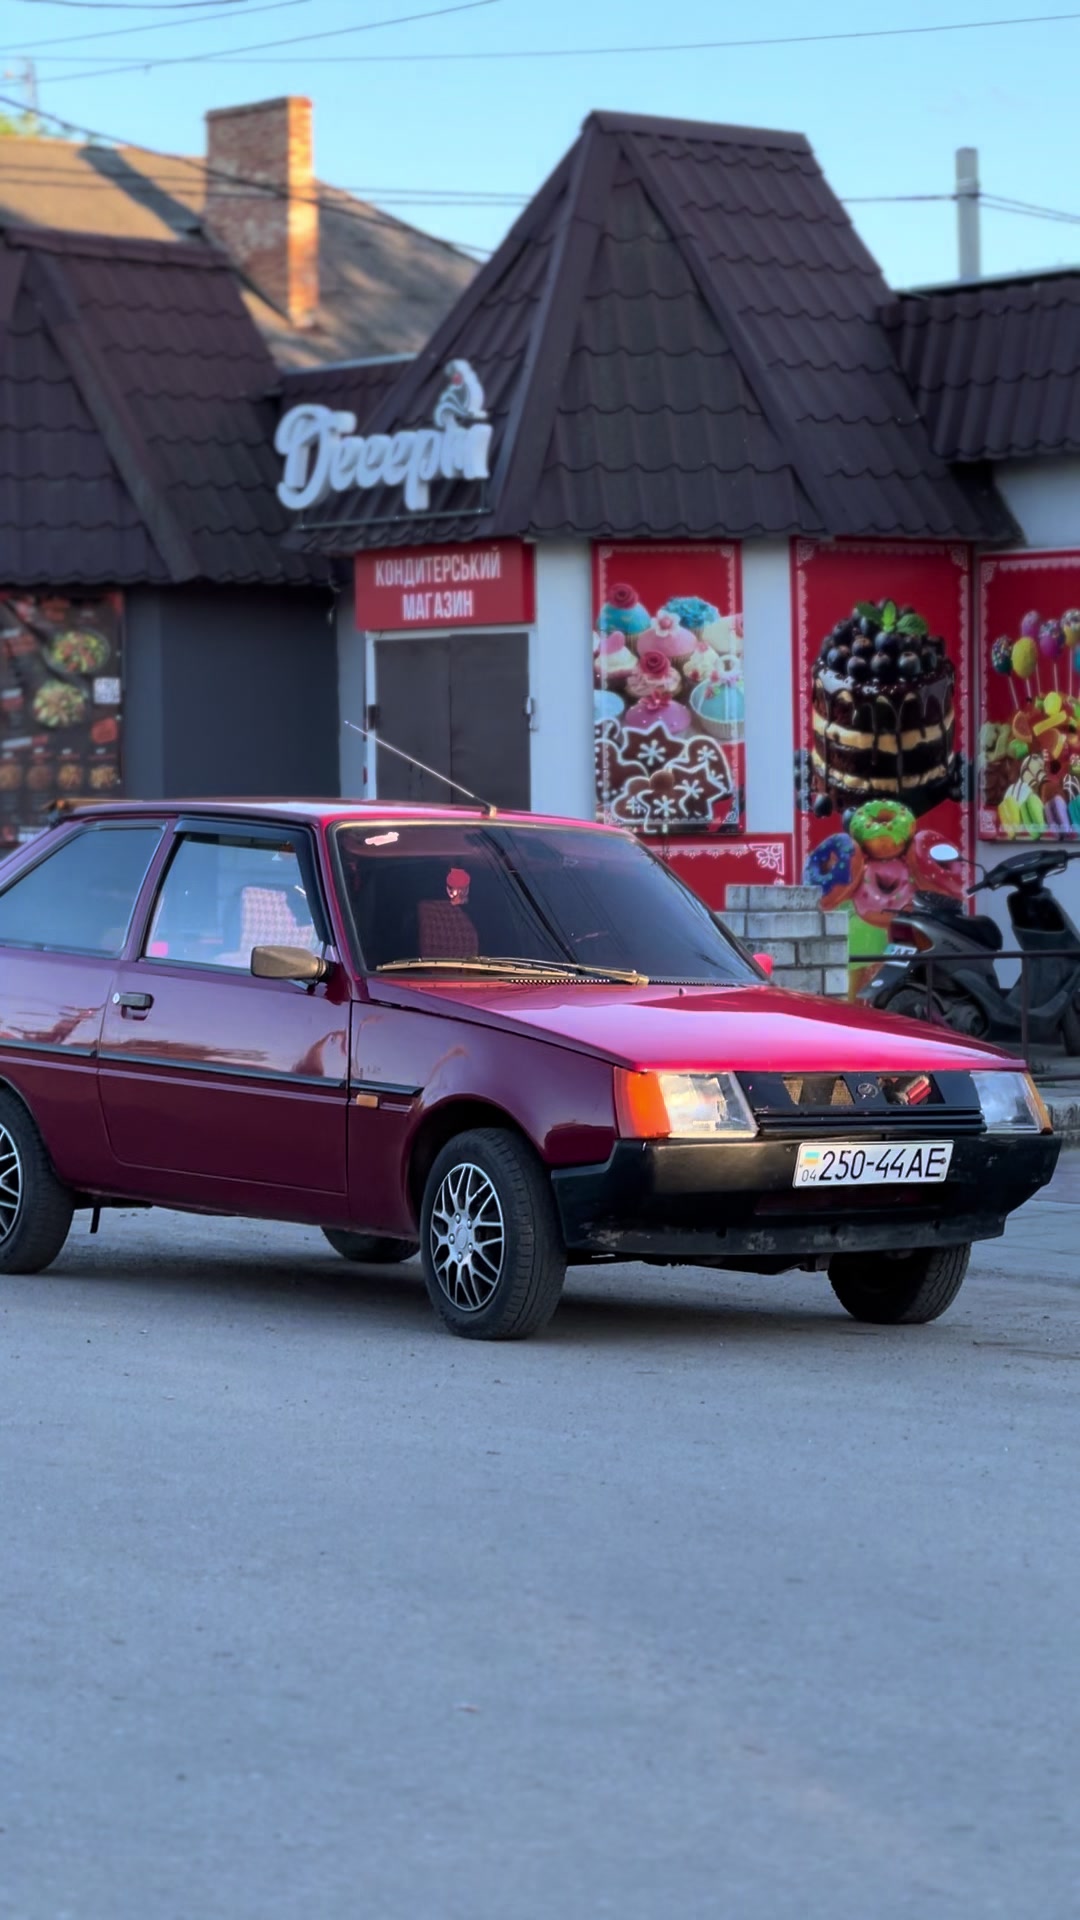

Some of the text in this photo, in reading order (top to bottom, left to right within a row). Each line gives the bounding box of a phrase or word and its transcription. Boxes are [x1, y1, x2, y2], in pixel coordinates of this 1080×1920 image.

[375, 546, 501, 587] КОНДИТЕРСЬКИЙ
[402, 590, 474, 620] МАГАЗИН
[801, 1169, 817, 1182] 04
